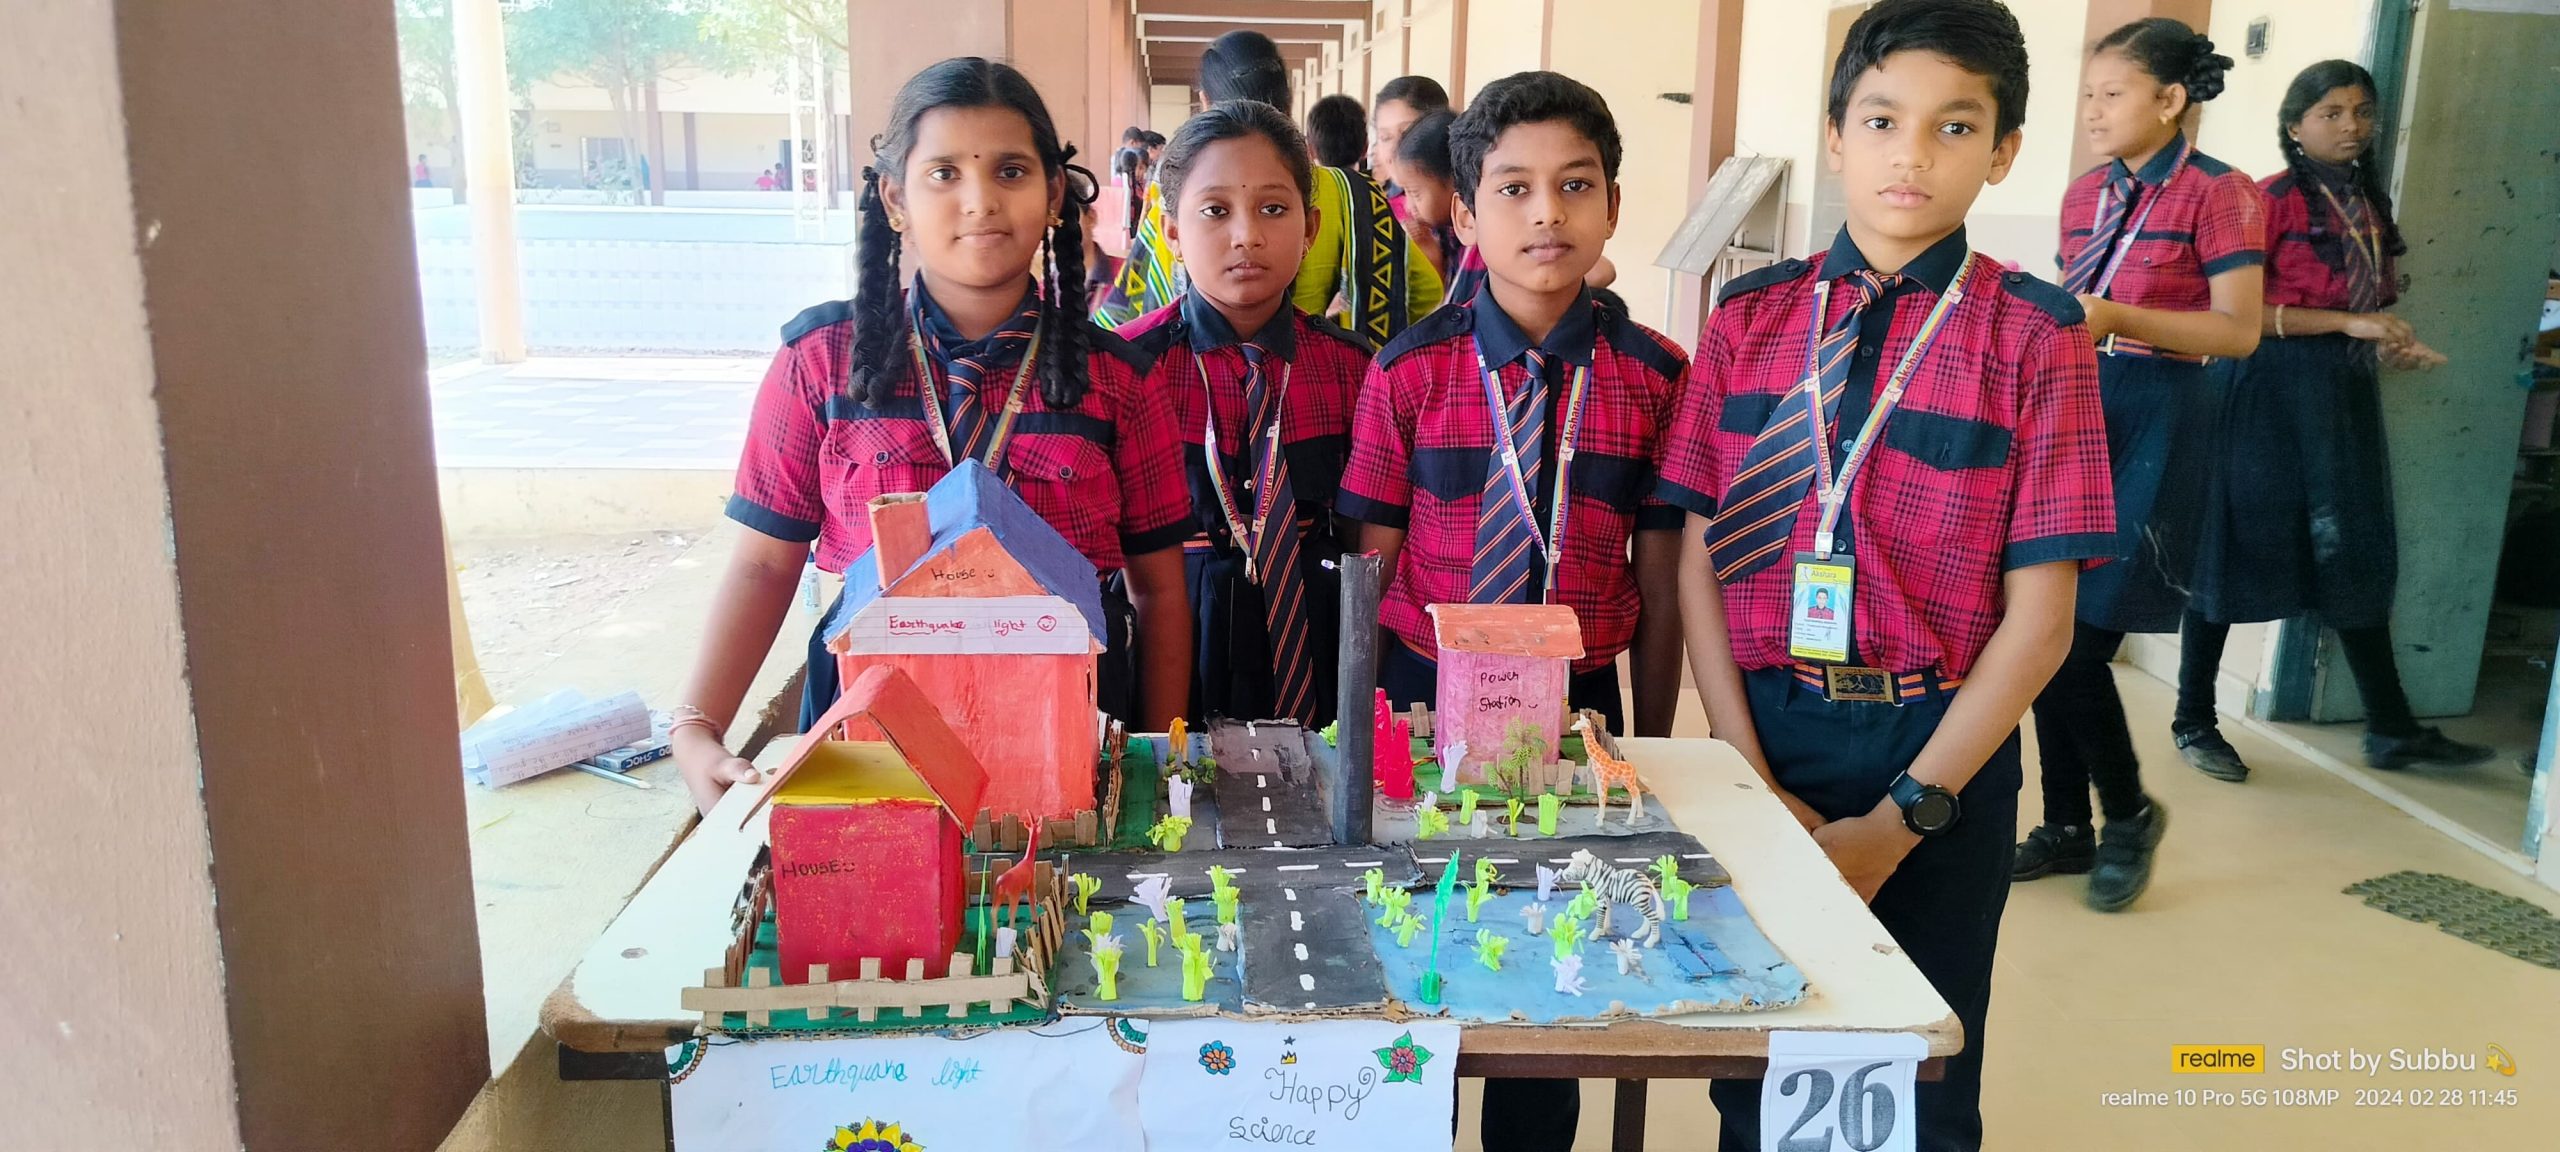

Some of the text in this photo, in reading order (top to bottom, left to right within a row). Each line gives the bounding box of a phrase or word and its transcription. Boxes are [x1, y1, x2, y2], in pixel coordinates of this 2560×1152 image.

[1809, 330, 1820, 371] Akshara
[1895, 340, 1927, 384] Akshara
[1014, 358, 1036, 398] Akshara
[922, 385, 940, 427] Akshara
[1497, 405, 1511, 446] Akshara
[1564, 400, 1581, 443] Akshara
[1818, 437, 1831, 484] Akshara
[1840, 442, 1868, 486] Akshara
[1220, 483, 1238, 521] Akshara
[1257, 477, 1272, 517] Akshara
[1524, 505, 1543, 546] Akshara
[1552, 503, 1566, 546] Akshara
[931, 568, 976, 581] House
[889, 615, 1026, 636] Earthquake light
[1479, 695, 1521, 712] Station
[781, 860, 840, 879] HOUSE
[932, 1057, 984, 1089] light
[1264, 1066, 1376, 1120] Happy
[1777, 1061, 1896, 1152] 26
[1229, 1116, 1316, 1145] Science
